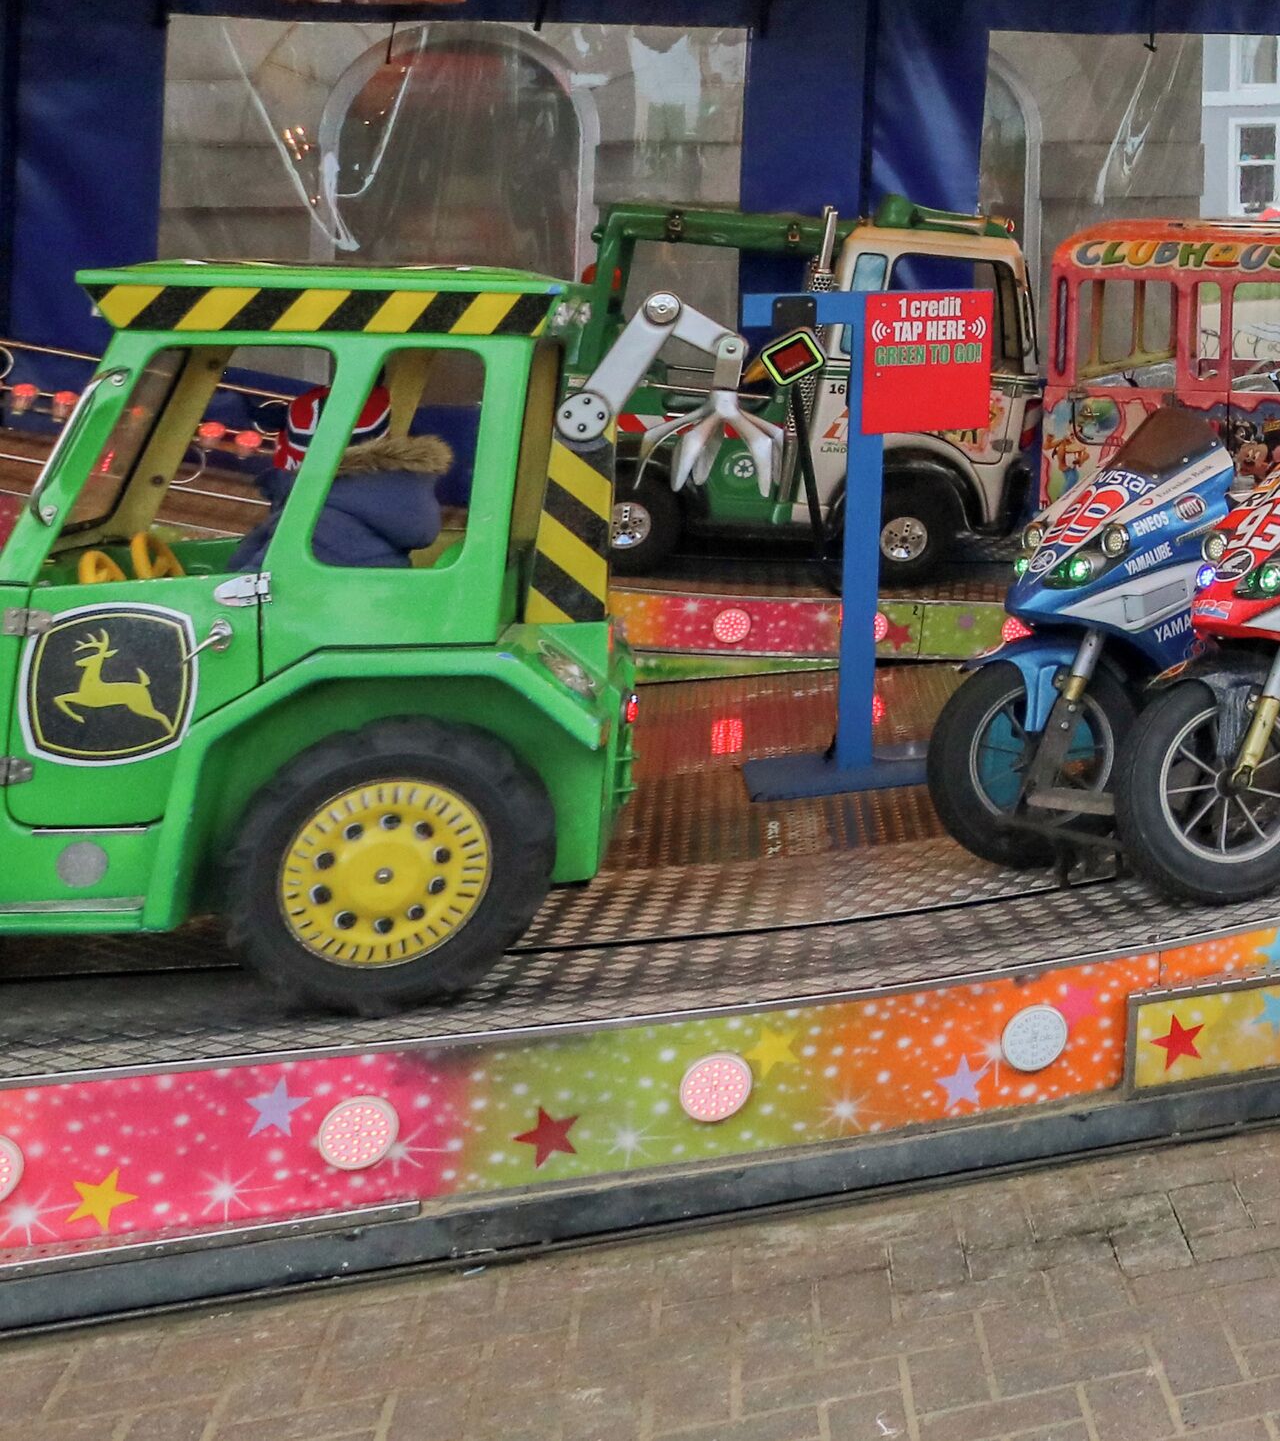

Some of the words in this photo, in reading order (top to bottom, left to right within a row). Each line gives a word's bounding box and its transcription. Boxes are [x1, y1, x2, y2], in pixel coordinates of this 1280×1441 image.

[899, 297, 907, 318] 1
[910, 296, 962, 317] credit
[892, 321, 923, 342] TAP
[926, 320, 966, 341] HERE
[875, 345, 927, 367] GREEN
[929, 344, 951, 365] TO
[954, 342, 983, 364] GO!
[1131, 510, 1170, 537] ENEOS
[1123, 541, 1174, 576] YAMALUBE
